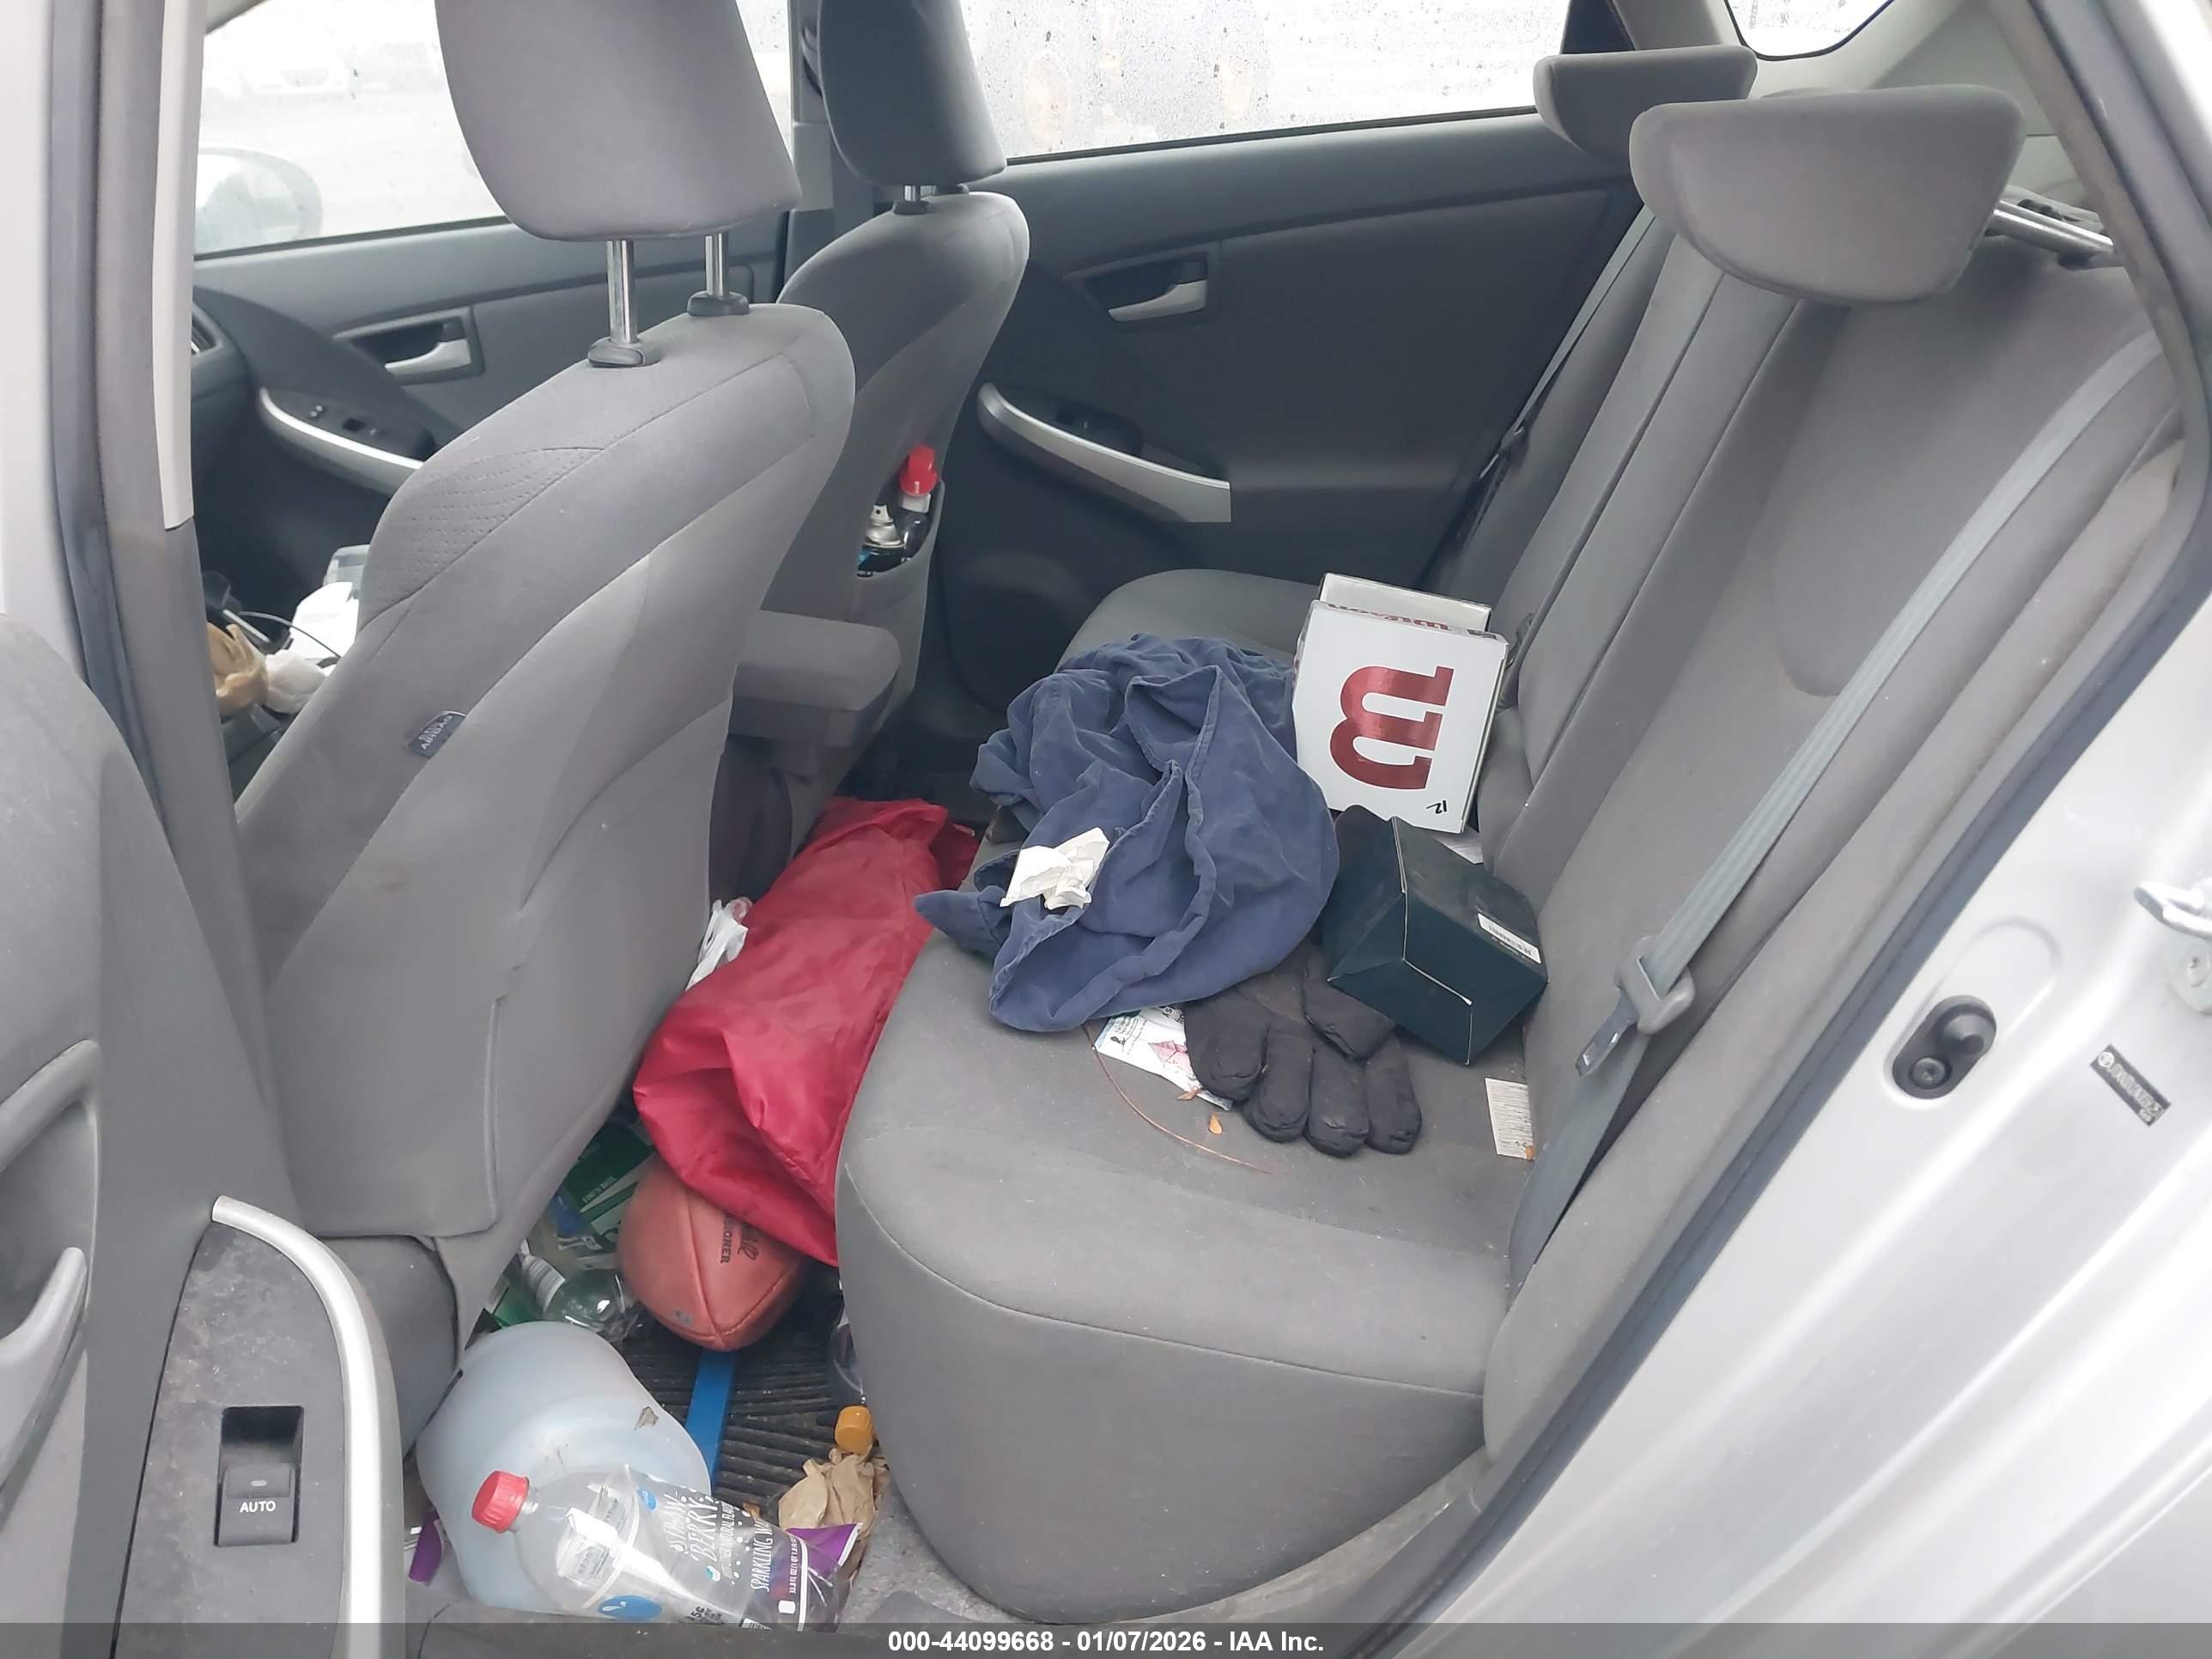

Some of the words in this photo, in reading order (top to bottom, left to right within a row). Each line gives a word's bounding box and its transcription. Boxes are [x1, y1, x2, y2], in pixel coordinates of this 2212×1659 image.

[240, 1500, 276, 1513] AUTO
[688, 1497, 718, 1562] BERRY
[750, 1537, 773, 1592] SPARKLING
